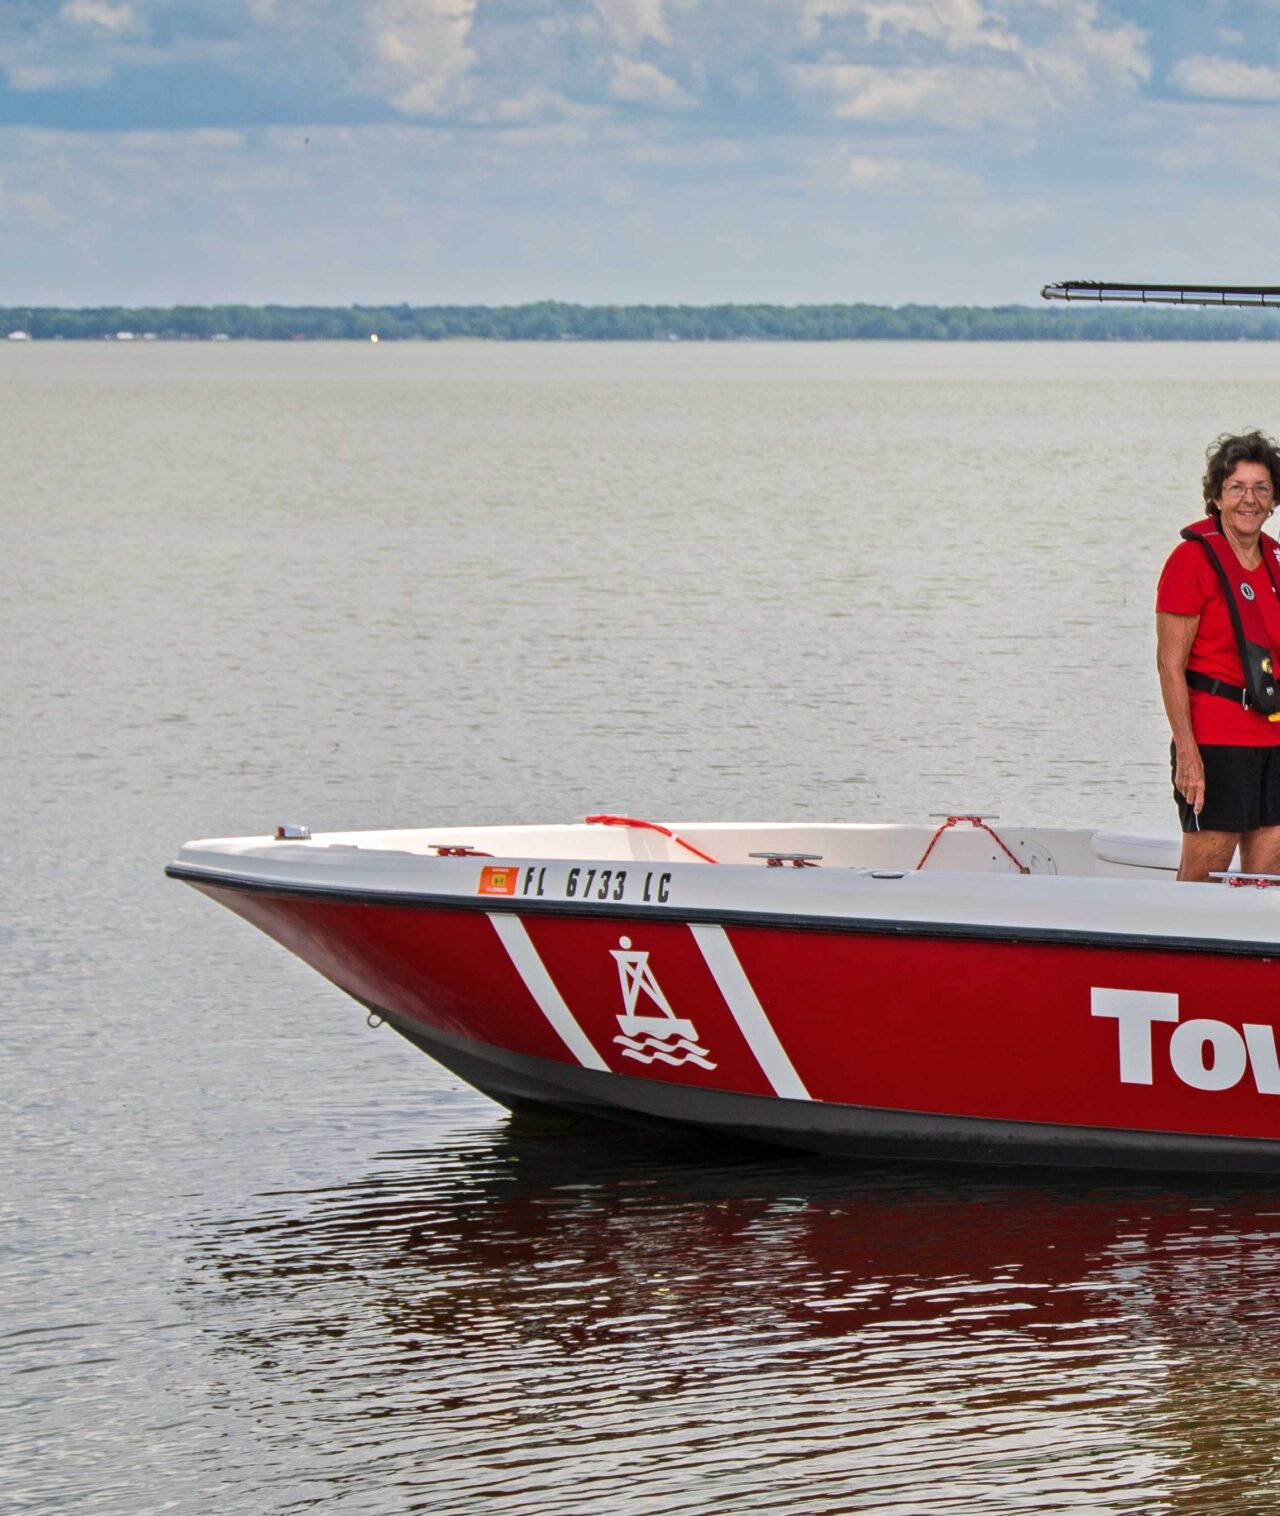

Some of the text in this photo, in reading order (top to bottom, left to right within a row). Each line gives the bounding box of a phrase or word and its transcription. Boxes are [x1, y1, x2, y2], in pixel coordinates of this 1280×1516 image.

[523, 866, 672, 903] FL 6733 LC
